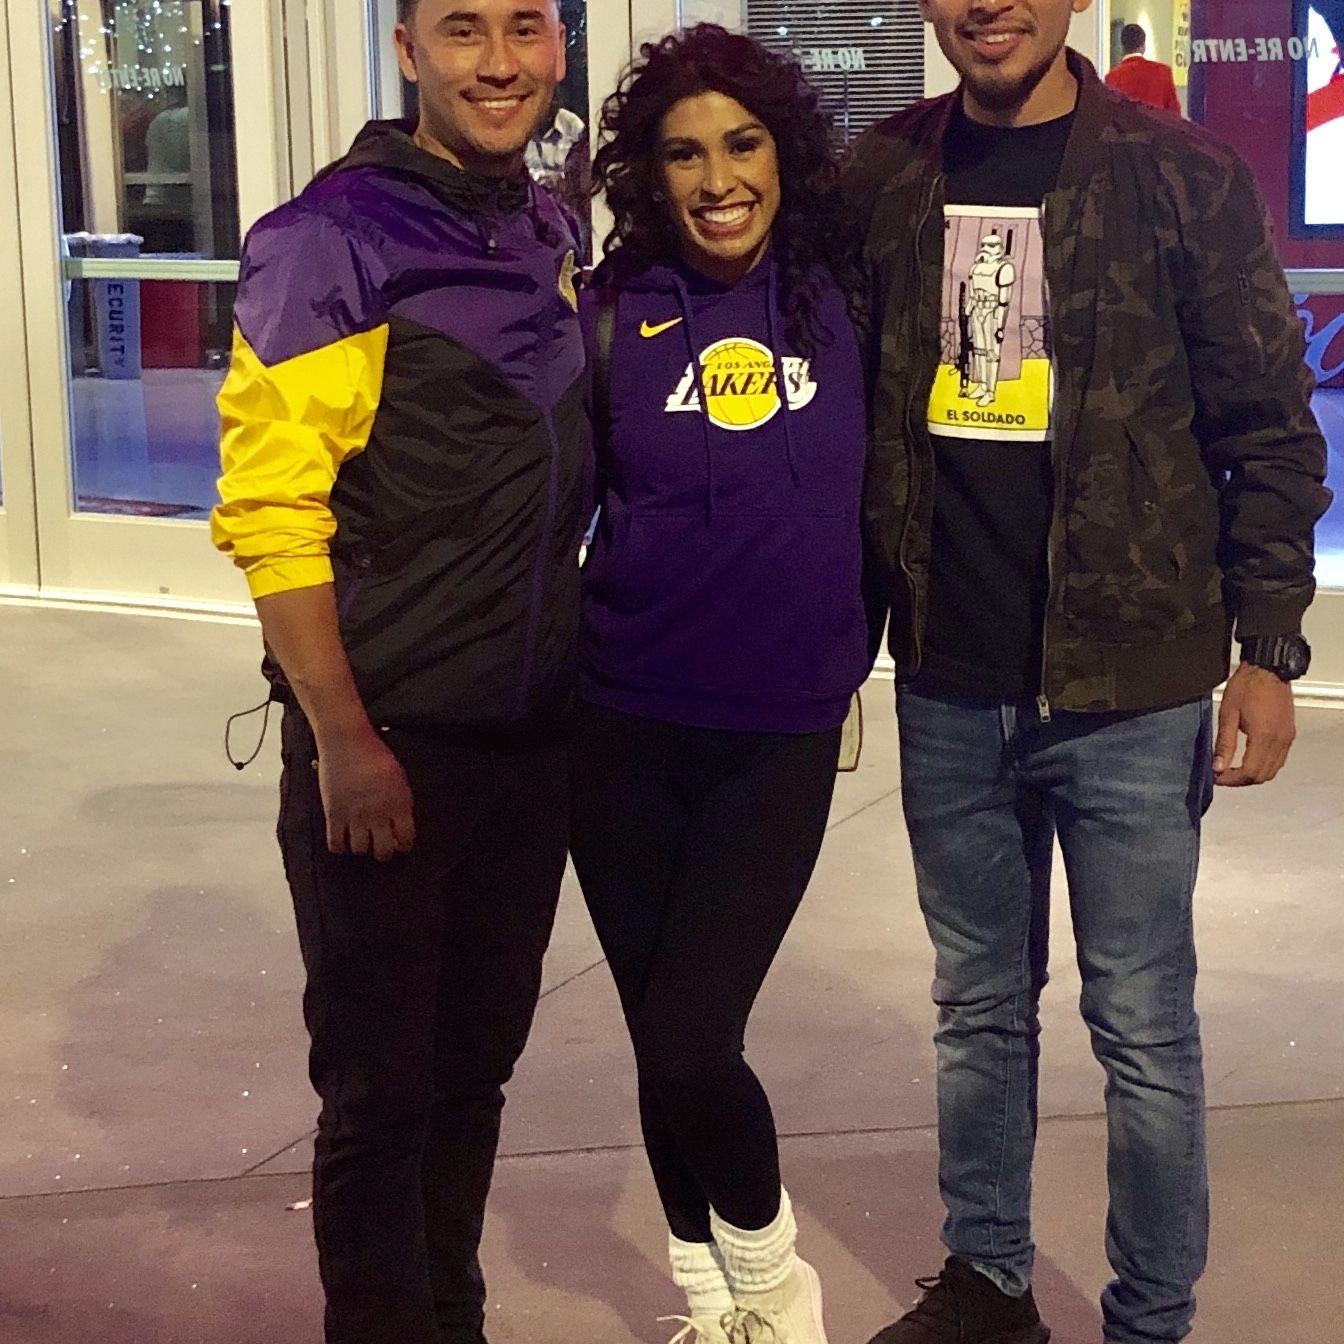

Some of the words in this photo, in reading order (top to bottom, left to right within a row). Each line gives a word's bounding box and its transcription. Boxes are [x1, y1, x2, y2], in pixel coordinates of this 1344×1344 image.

[106, 282, 125, 369] ECURITY
[946, 409, 959, 421] EL
[962, 410, 1026, 425] SOLDADO
